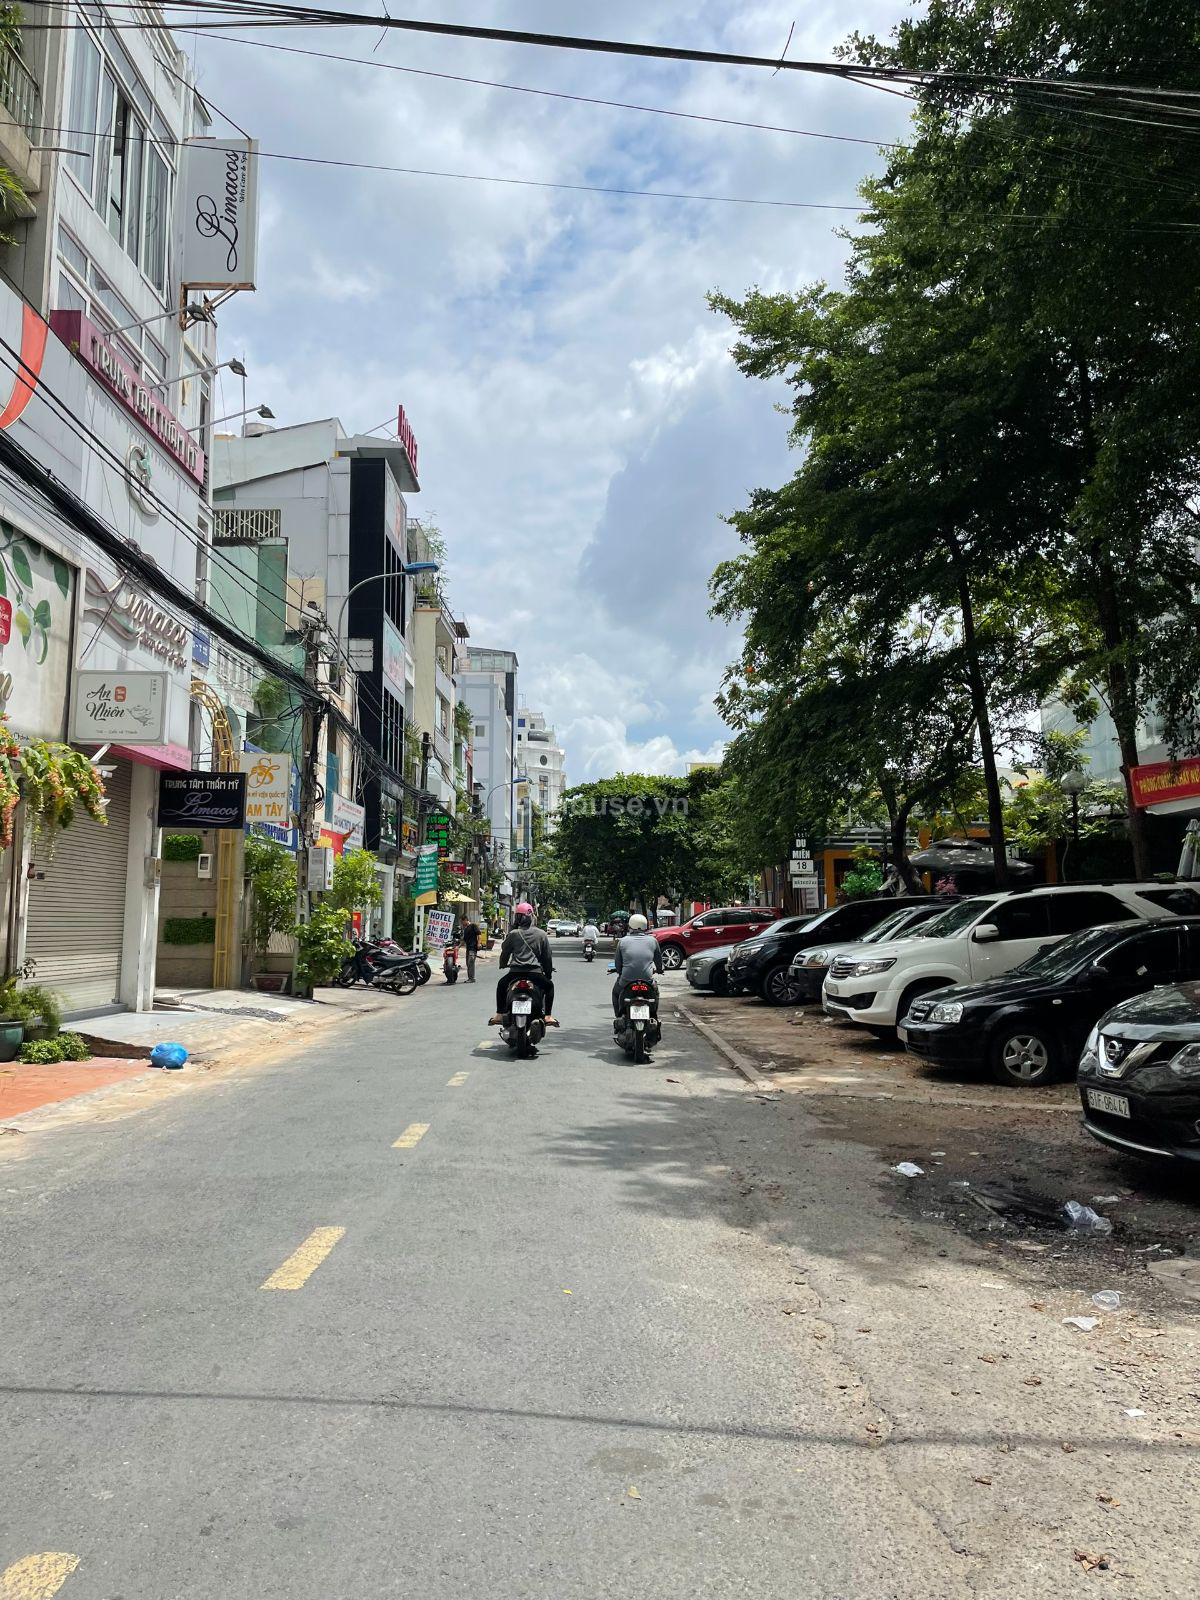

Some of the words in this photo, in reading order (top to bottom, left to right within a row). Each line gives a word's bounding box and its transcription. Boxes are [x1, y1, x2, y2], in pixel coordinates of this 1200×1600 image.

[196, 150, 239, 272] Limacos
[86, 683, 111, 702] An
[86, 701, 125, 721] Nhiên
[165, 780, 187, 789] TRUNG
[189, 778, 204, 789] TÂM
[227, 779, 240, 790] MỸ
[161, 791, 239, 817] Limacos
[247, 803, 263, 816] AM
[265, 801, 284, 816] TÂY
[796, 861, 807, 870] 18
[430, 911, 453, 922] HOTEL
